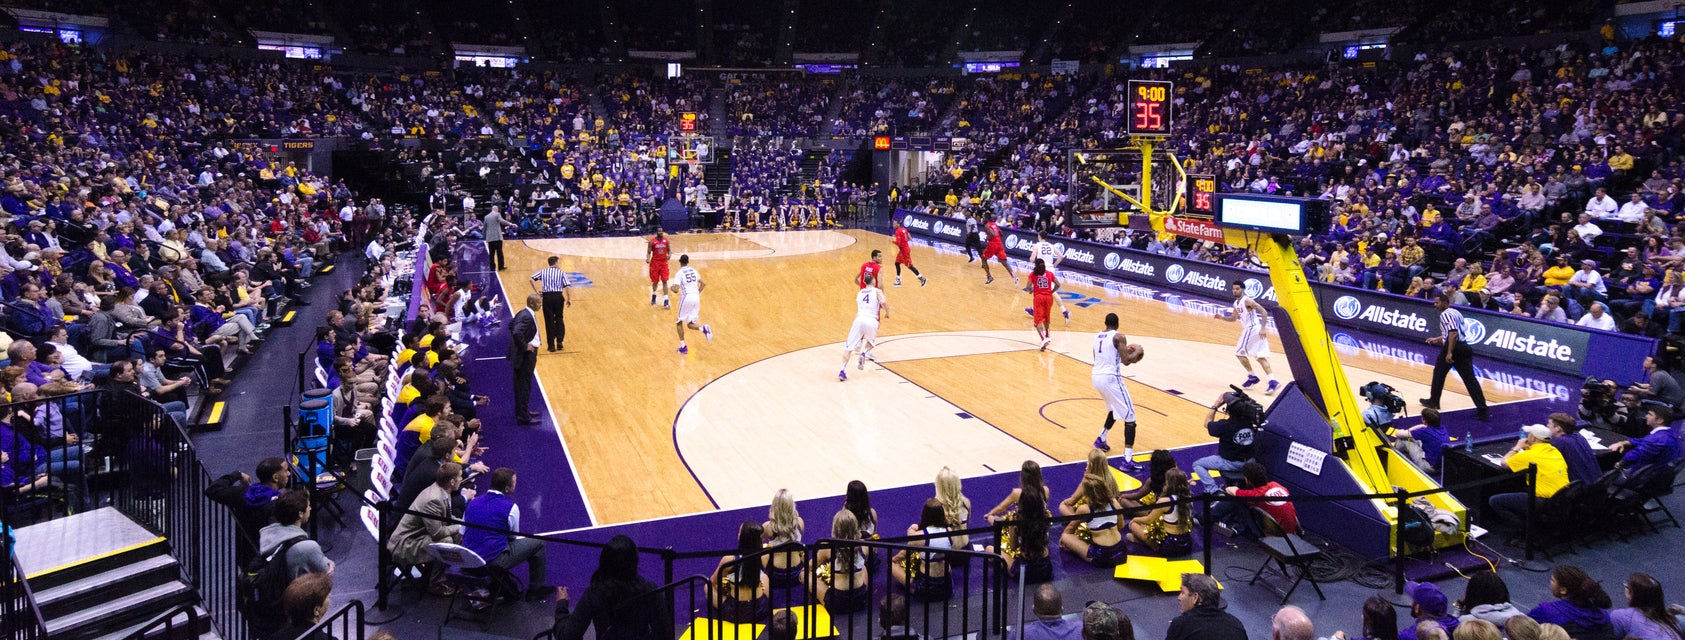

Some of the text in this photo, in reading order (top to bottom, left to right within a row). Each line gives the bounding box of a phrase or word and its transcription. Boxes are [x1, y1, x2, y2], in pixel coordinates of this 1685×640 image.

[1138, 86, 1165, 101] 9:00
[1136, 103, 1160, 128] 35
[682, 120, 694, 130] 35
[1196, 179, 1213, 192] 9:00
[1196, 194, 1209, 209] 35
[1041, 246, 1052, 255] 22
[685, 272, 697, 283] 55
[1037, 276, 1049, 288] 42
[862, 293, 870, 304] 4
[1098, 340, 1103, 353] 1
[1238, 432, 1252, 440] FOX
